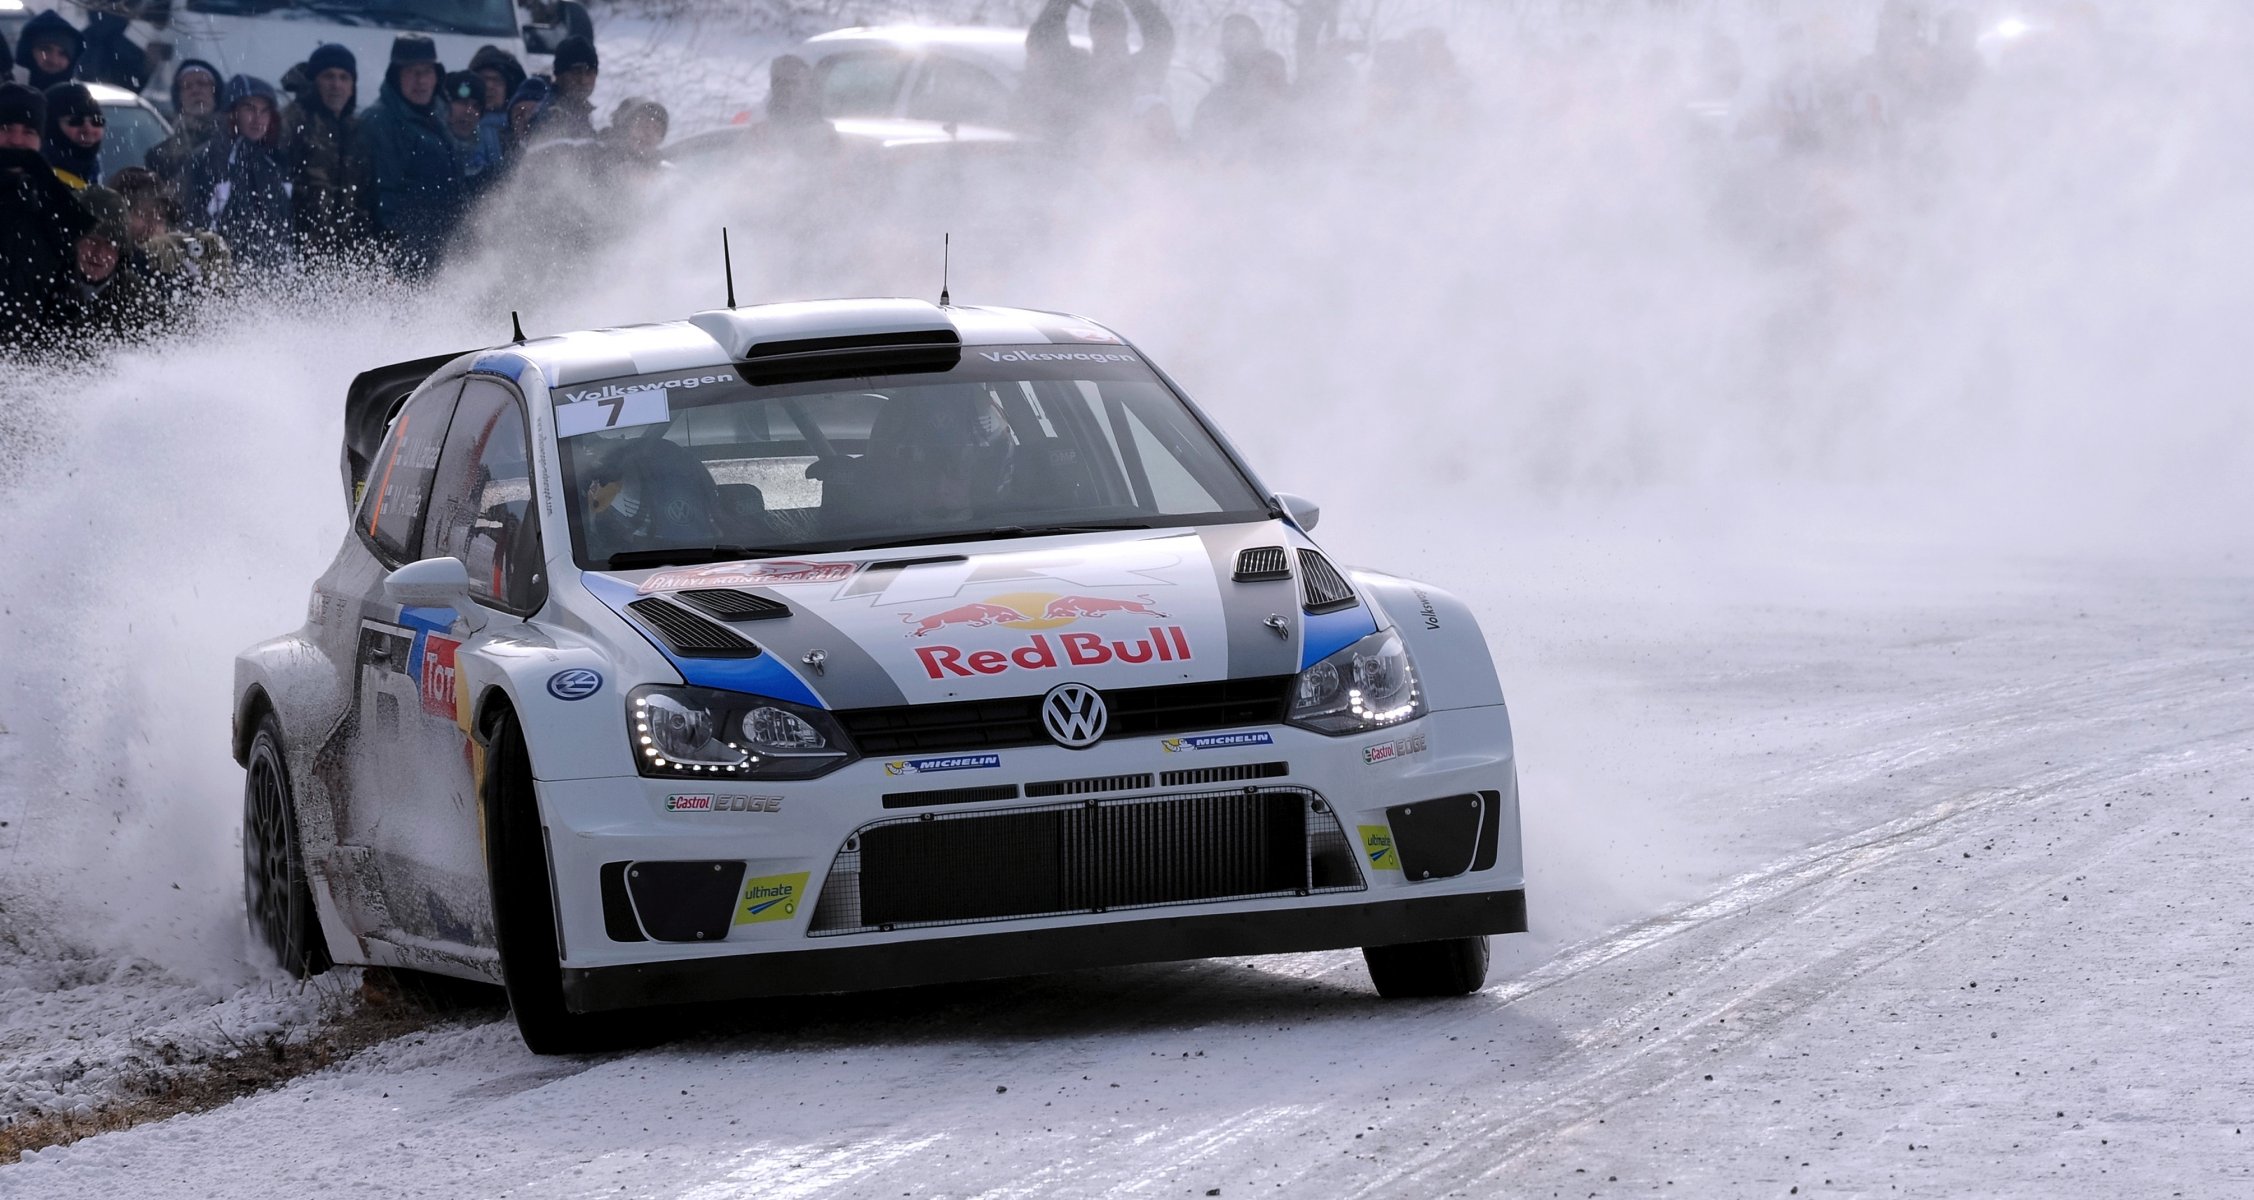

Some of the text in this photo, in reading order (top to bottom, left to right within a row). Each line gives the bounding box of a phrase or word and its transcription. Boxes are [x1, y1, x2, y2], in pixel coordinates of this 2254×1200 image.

[981, 350, 1136, 363] Volkswagen
[566, 374, 734, 403] Volkswagen
[597, 396, 625, 427] 7
[915, 626, 1191, 679] Red Bull
[1043, 683, 1108, 747] VW
[1196, 733, 1268, 746] MICHELIN
[1371, 734, 1427, 761] Castrol EDGE
[920, 756, 997, 769] MICHELIN
[676, 794, 784, 813] Castrol EDGE
[1367, 833, 1391, 846] ultimate
[745, 883, 792, 900] ultimate
